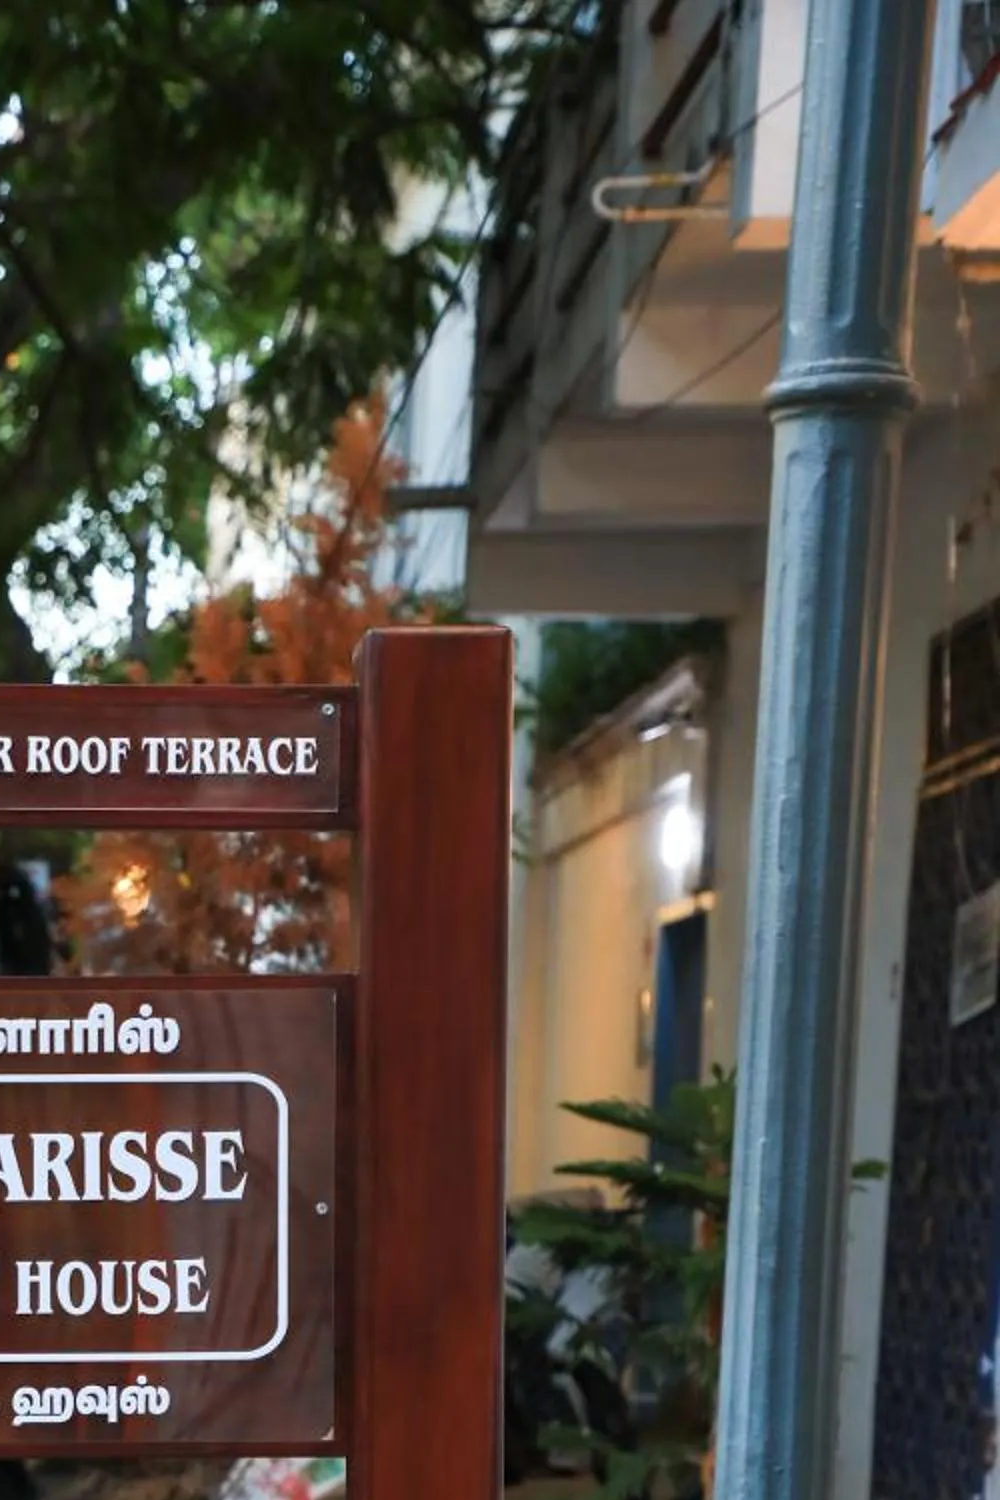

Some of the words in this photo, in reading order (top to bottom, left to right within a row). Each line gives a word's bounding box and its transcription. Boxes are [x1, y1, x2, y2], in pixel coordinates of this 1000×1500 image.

[26, 736, 131, 774] ROOF
[141, 737, 319, 775] TERRACE
[15, 1257, 209, 1316] HOUSE
[12, 1375, 171, 1426] ஹவுஸ்
